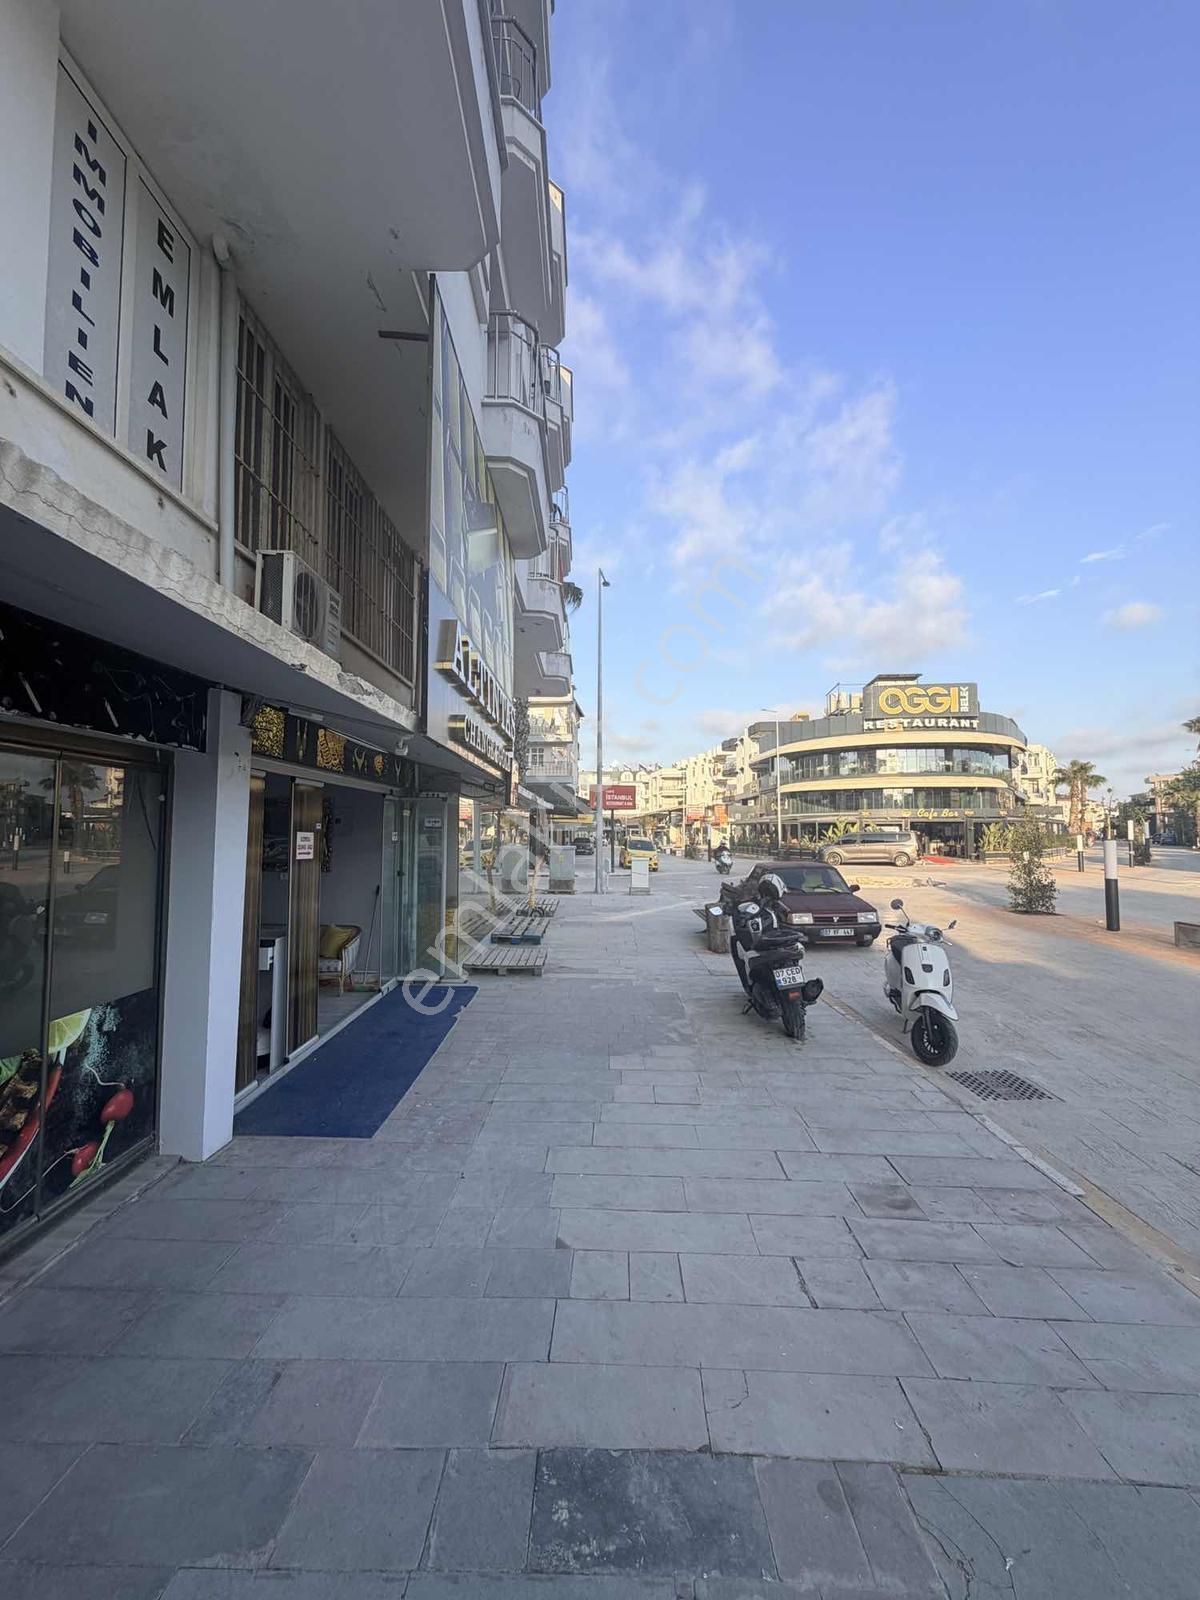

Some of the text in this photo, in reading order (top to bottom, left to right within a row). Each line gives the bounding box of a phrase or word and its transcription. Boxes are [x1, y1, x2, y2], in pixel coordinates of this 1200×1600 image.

[146, 217, 176, 473] EMLAK
[879, 686, 960, 715] OGGI
[959, 686, 970, 713] BELEK
[863, 717, 980, 731] RESTAURANT
[774, 970, 785, 978] 07
